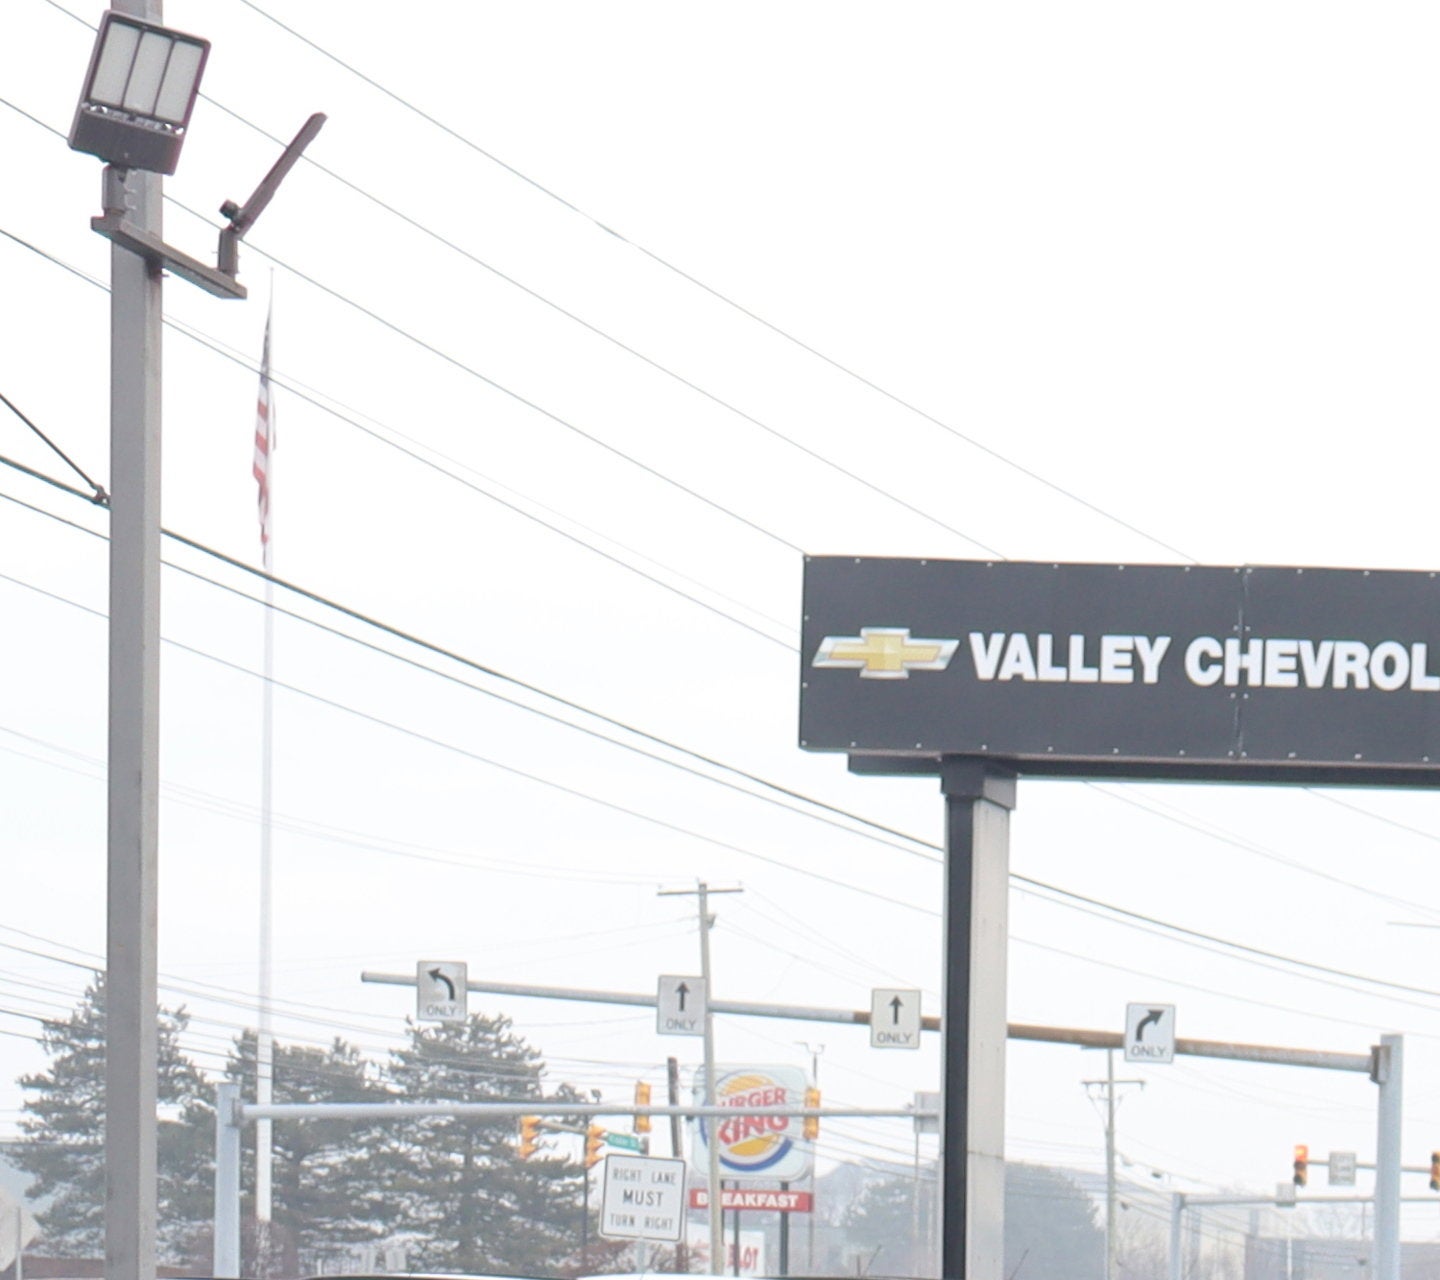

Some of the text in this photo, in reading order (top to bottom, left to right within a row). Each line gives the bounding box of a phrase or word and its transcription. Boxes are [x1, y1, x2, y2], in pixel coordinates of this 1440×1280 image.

[969, 631, 1171, 684] VALLEY
[426, 1004, 456, 1017] ONLY
[666, 1018, 696, 1031] ONLY
[877, 1032, 913, 1045] ONLY
[1131, 1044, 1166, 1058] ONLY
[612, 1167, 676, 1185] RIGHT LANE
[622, 1188, 663, 1207] MUST
[697, 1192, 798, 1208] BEAKFAST
[610, 1213, 674, 1231] TURN RIGHT
